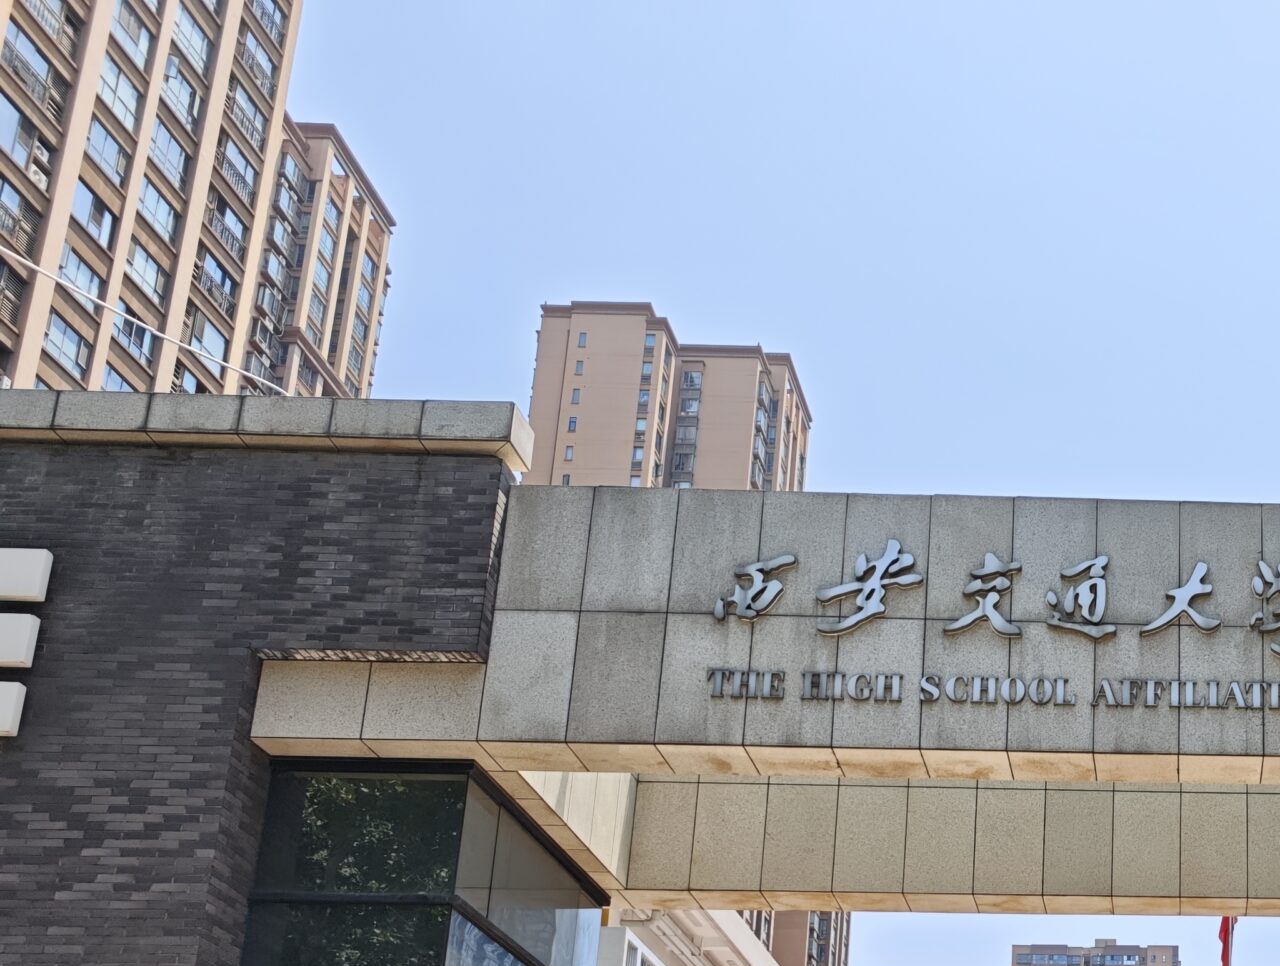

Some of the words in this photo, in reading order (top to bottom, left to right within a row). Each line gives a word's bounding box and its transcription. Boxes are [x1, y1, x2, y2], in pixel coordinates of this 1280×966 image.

[707, 668, 785, 699] THE
[801, 671, 903, 702] HIGH
[919, 674, 1076, 707] SCHOOL
